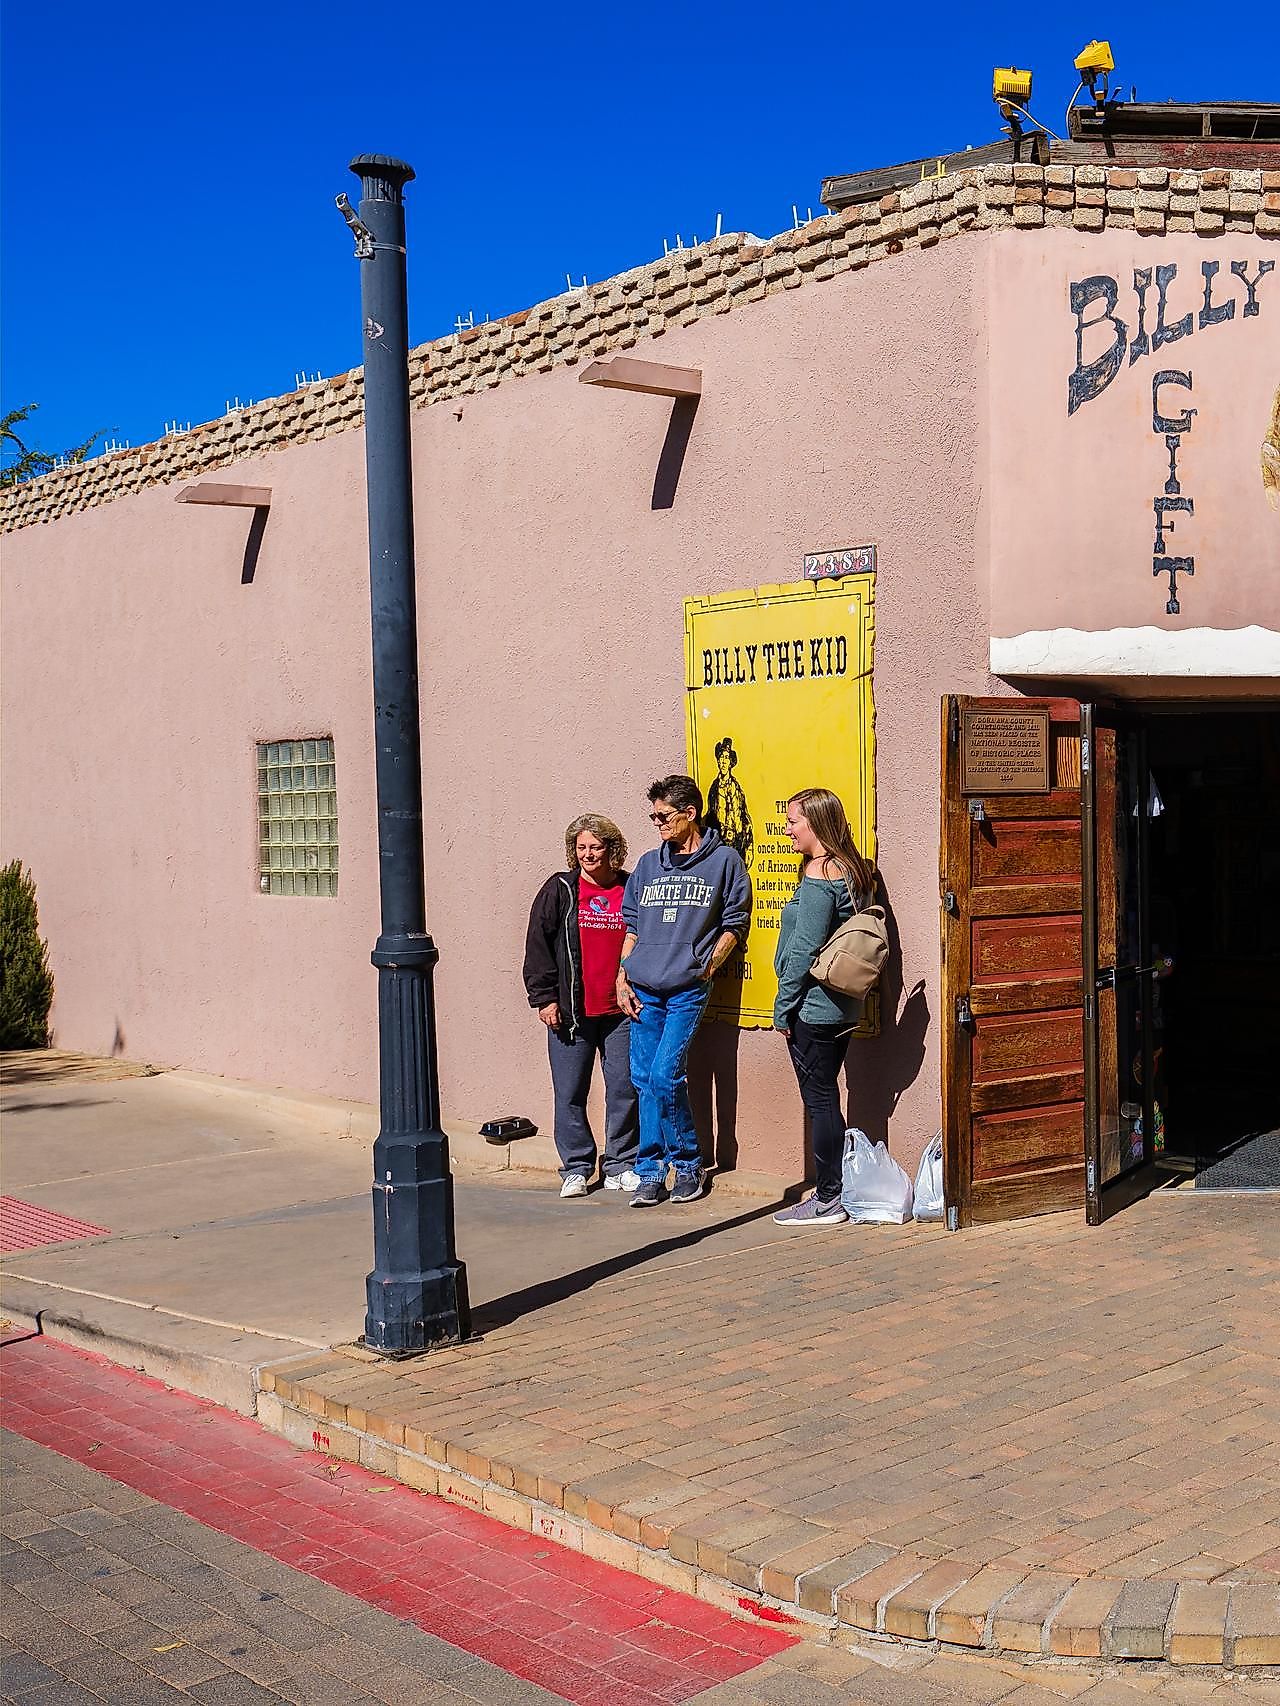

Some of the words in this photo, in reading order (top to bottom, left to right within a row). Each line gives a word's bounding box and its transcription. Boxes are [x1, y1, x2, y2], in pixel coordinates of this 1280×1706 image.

[1068, 260, 1275, 417] BILLY
[1152, 370, 1198, 614] GIFT
[808, 550, 869, 575] 2385
[702, 644, 758, 686] BILLY
[762, 639, 805, 681] THE
[809, 635, 847, 677] KID
[775, 801, 788, 814] TH
[765, 822, 788, 836] Whic
[757, 844, 775, 854] once
[758, 860, 765, 873] of
[768, 860, 797, 873] Arizona
[756, 878, 775, 891] Later
[777, 879, 784, 891] it
[640, 884, 682, 907] DONATE
[685, 884, 715, 907] LIFE
[756, 897, 764, 910] in
[757, 916, 774, 929] tried
